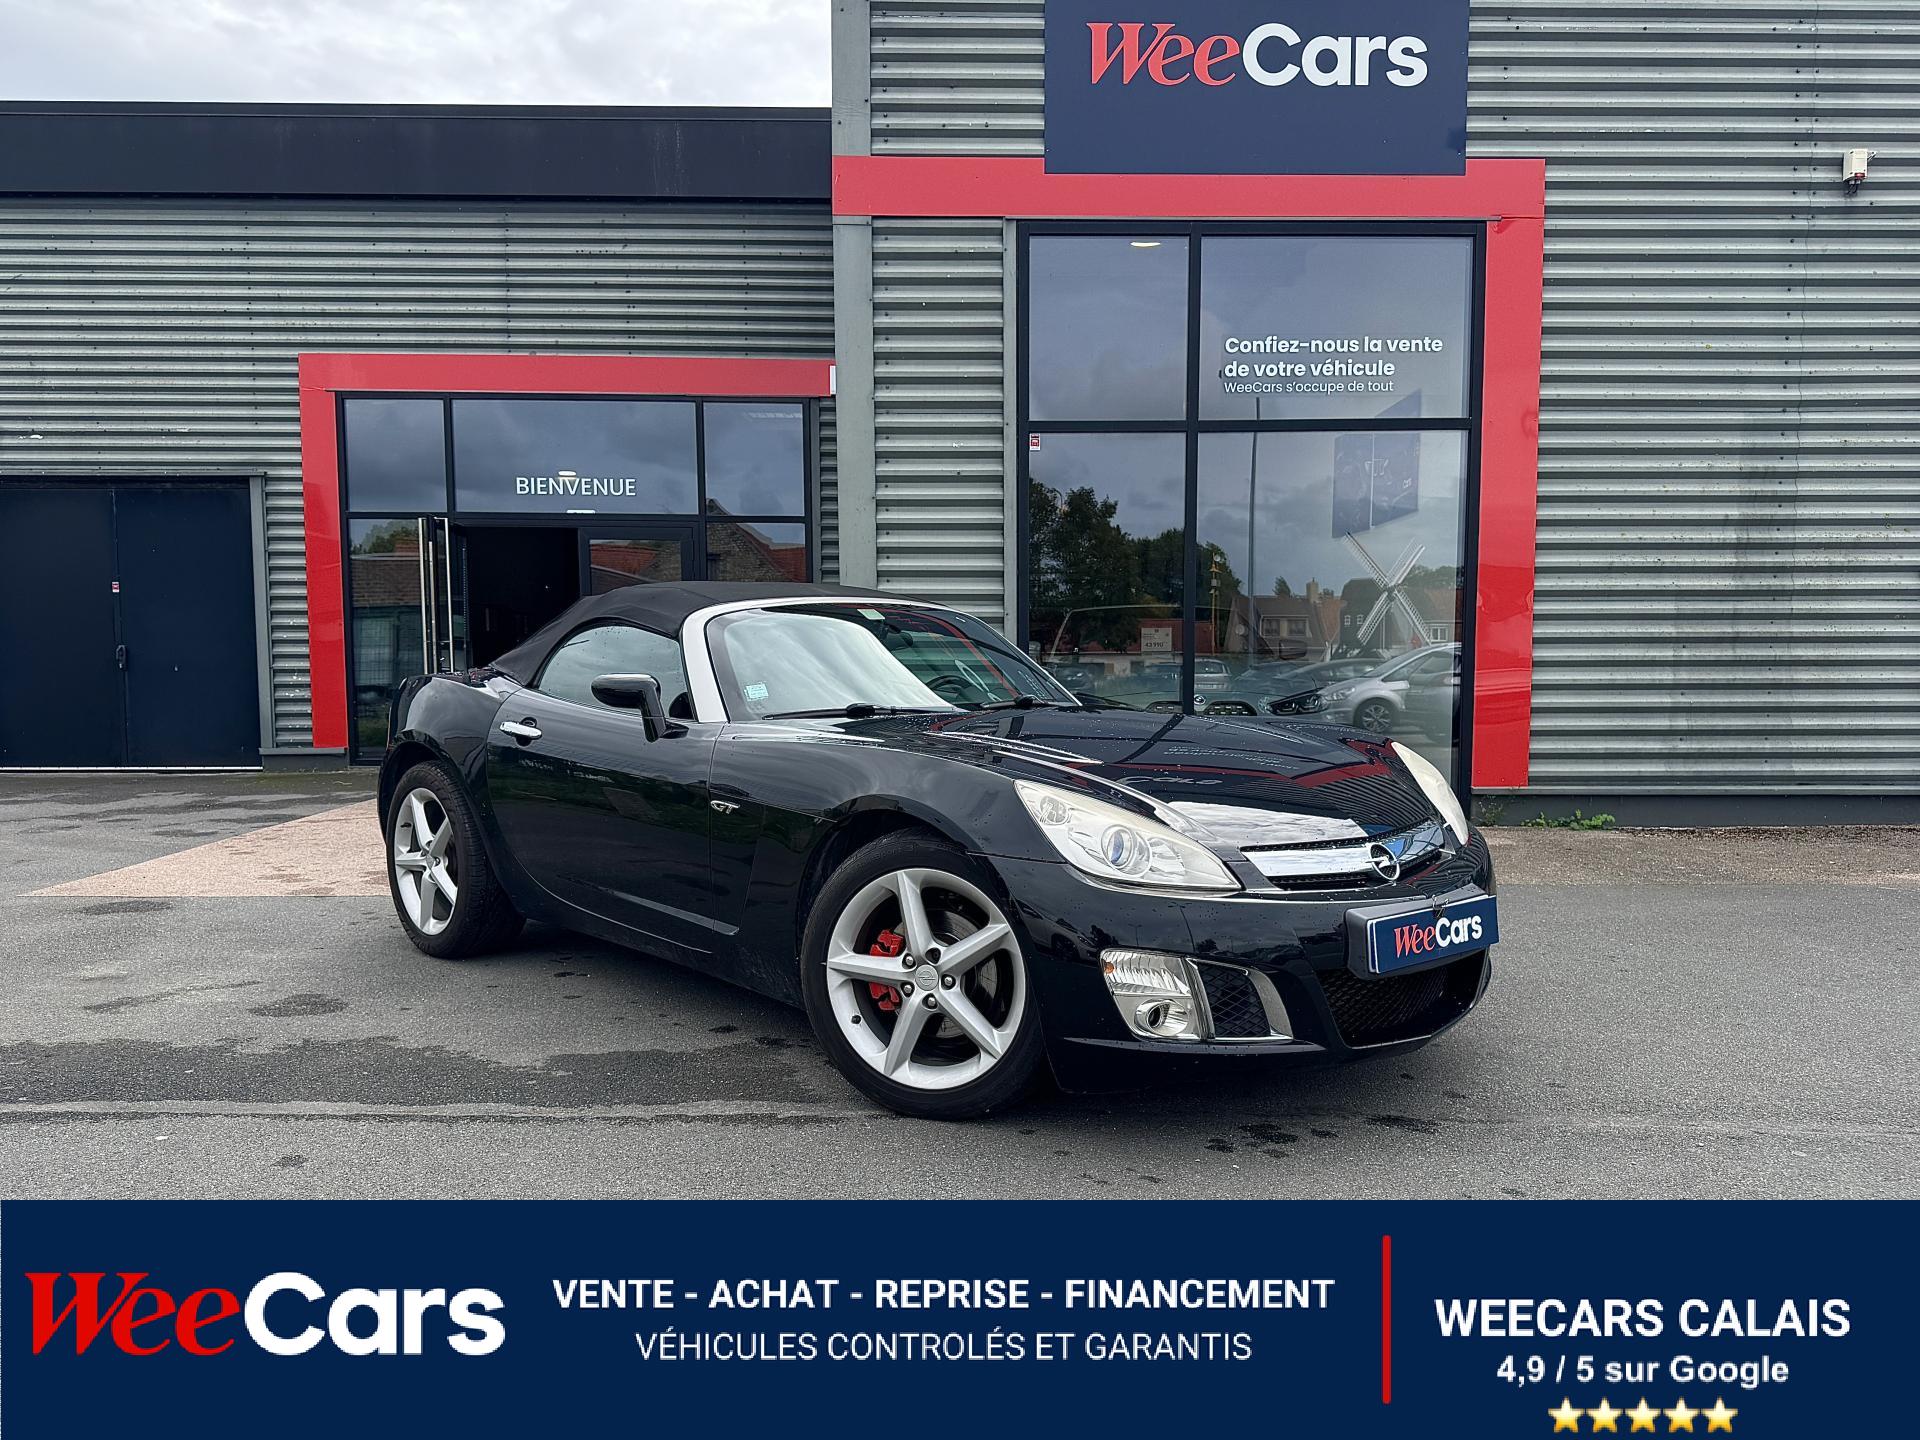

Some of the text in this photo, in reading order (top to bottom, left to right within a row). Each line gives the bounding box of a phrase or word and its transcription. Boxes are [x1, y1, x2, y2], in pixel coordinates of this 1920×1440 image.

[1086, 22, 1428, 87] WeeCars
[1225, 335, 1443, 353] Confiez-nous la vente
[1224, 358, 1395, 377] de votre véhicule
[1224, 381, 1283, 393] WeeCars
[1347, 381, 1365, 392] de
[1368, 381, 1394, 392] tout
[515, 476, 637, 497] BIENVENUE
[710, 800, 740, 814] GT
[1394, 915, 1483, 958] WeeCars
